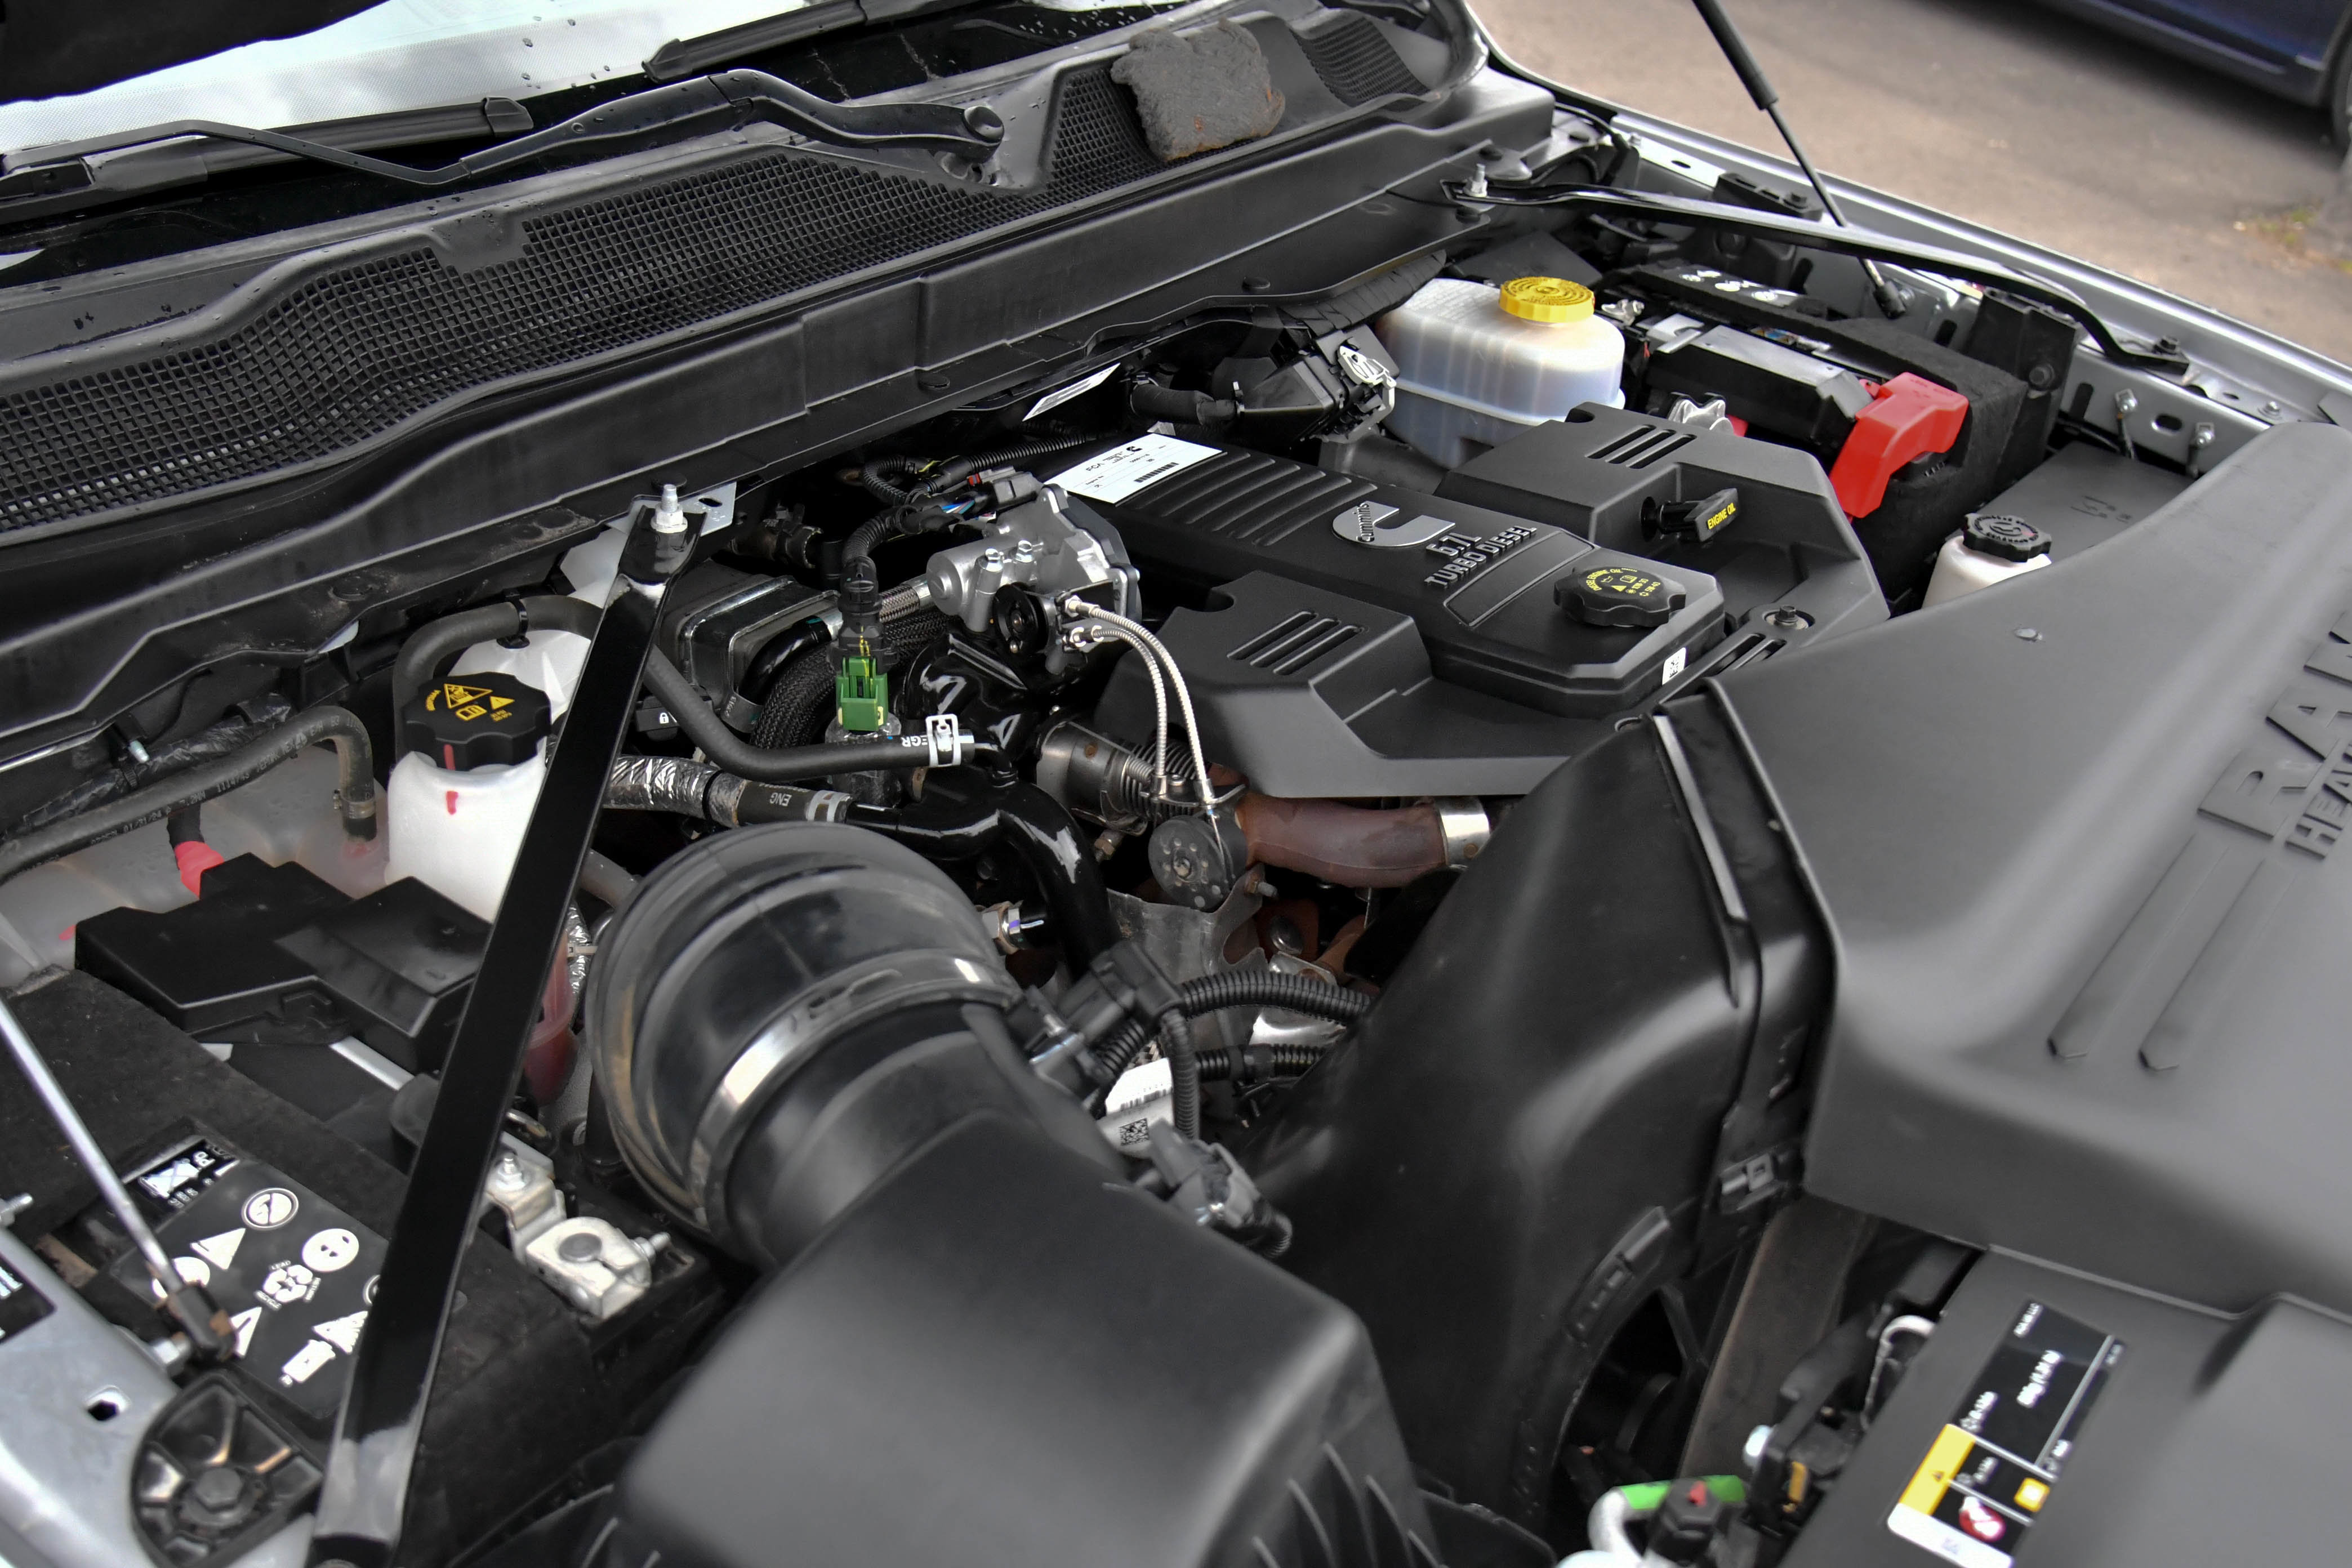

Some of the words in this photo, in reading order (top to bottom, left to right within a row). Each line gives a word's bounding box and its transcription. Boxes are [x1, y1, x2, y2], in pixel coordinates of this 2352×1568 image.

[1352, 502, 1375, 542] Cummins
[1707, 508, 1728, 529] ENGINE
[1727, 502, 1736, 515] OIL
[1426, 532, 1482, 558] 6.7L
[1424, 551, 1487, 589] TURBO
[1475, 525, 1537, 558] DIESEL
[901, 734, 929, 747] EGR
[770, 792, 792, 807] ENG
[270, 1260, 291, 1270] LEAD
[255, 1290, 282, 1309] RECYCLE
